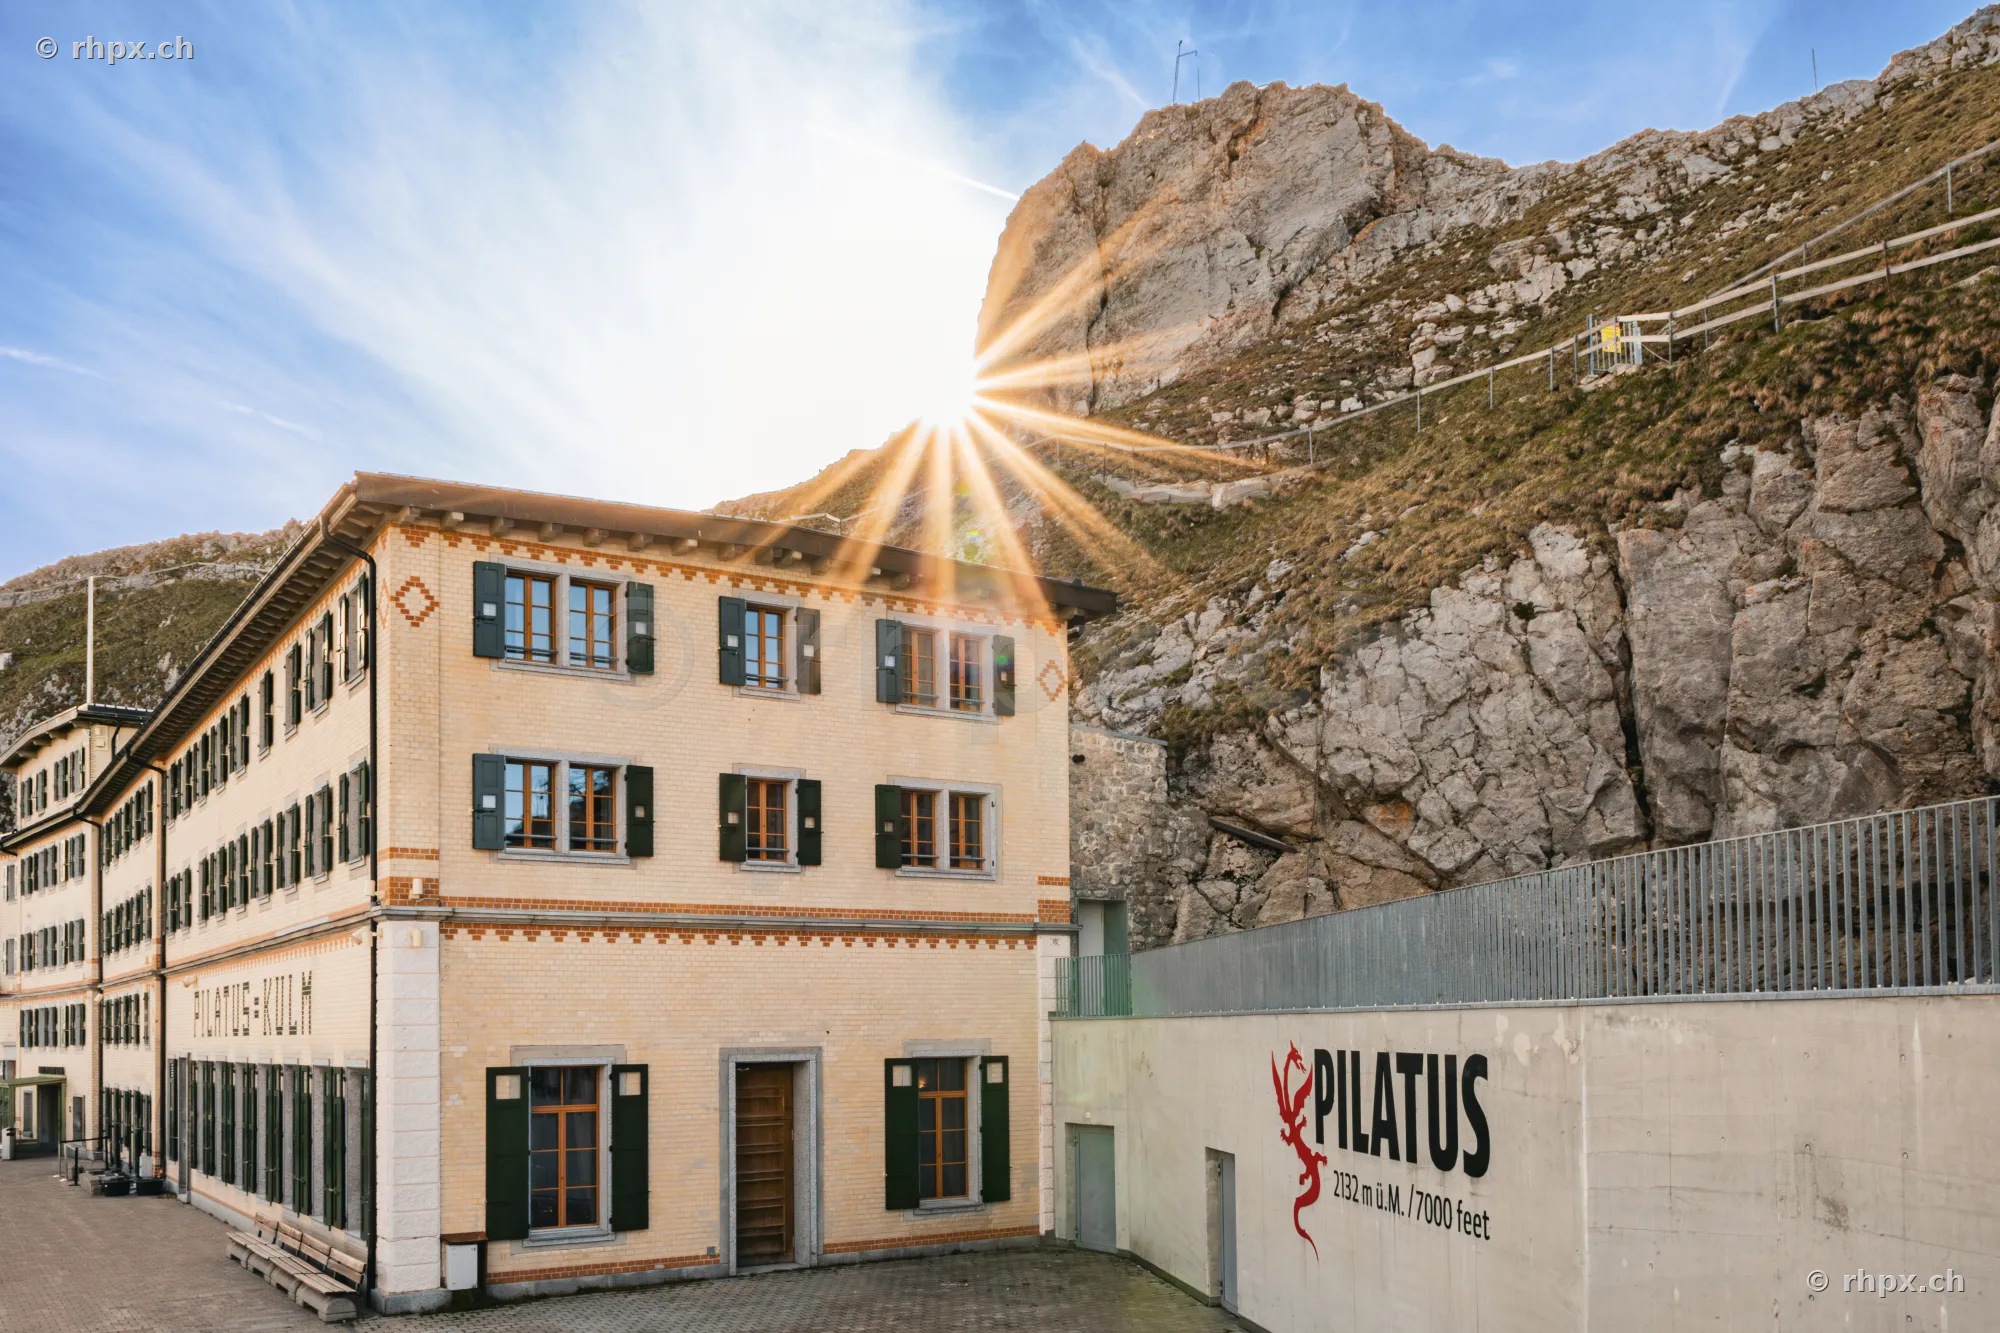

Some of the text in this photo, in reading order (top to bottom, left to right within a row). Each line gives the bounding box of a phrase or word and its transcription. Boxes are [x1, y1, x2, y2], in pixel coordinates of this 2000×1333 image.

[1314, 1048, 1491, 1179] PILATUS
[1333, 1169, 1359, 1203] 2132
[1362, 1184, 1373, 1207] m
[1456, 1199, 1491, 1241] feet
